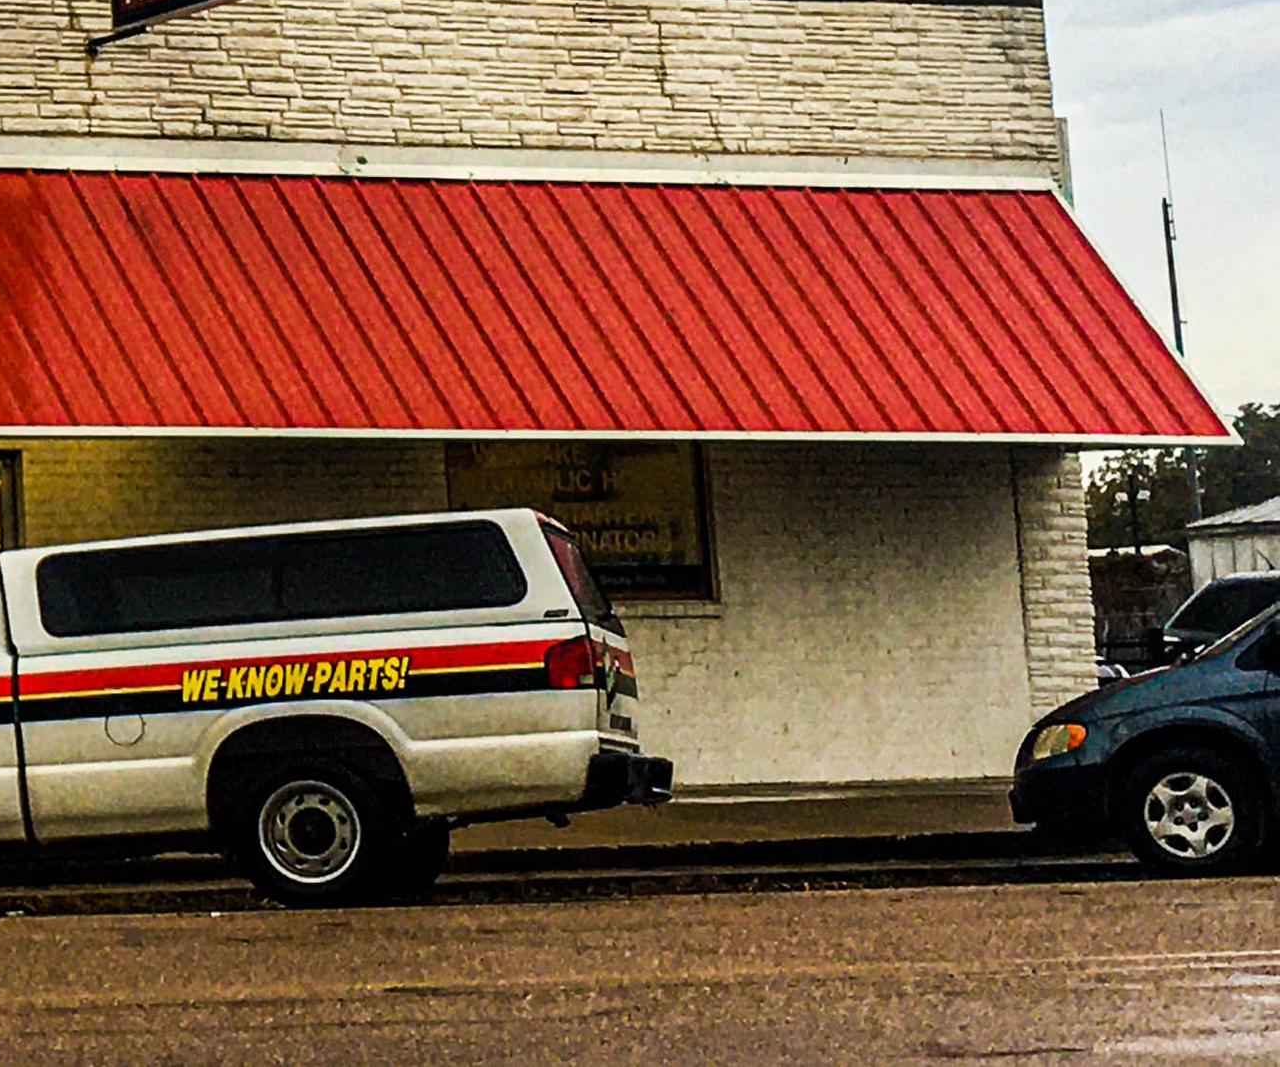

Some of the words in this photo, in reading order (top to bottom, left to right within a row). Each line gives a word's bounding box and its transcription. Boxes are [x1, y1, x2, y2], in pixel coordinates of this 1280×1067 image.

[182, 669, 220, 702] WE
[226, 662, 310, 700] KNOW
[313, 657, 410, 694] PARTS!
